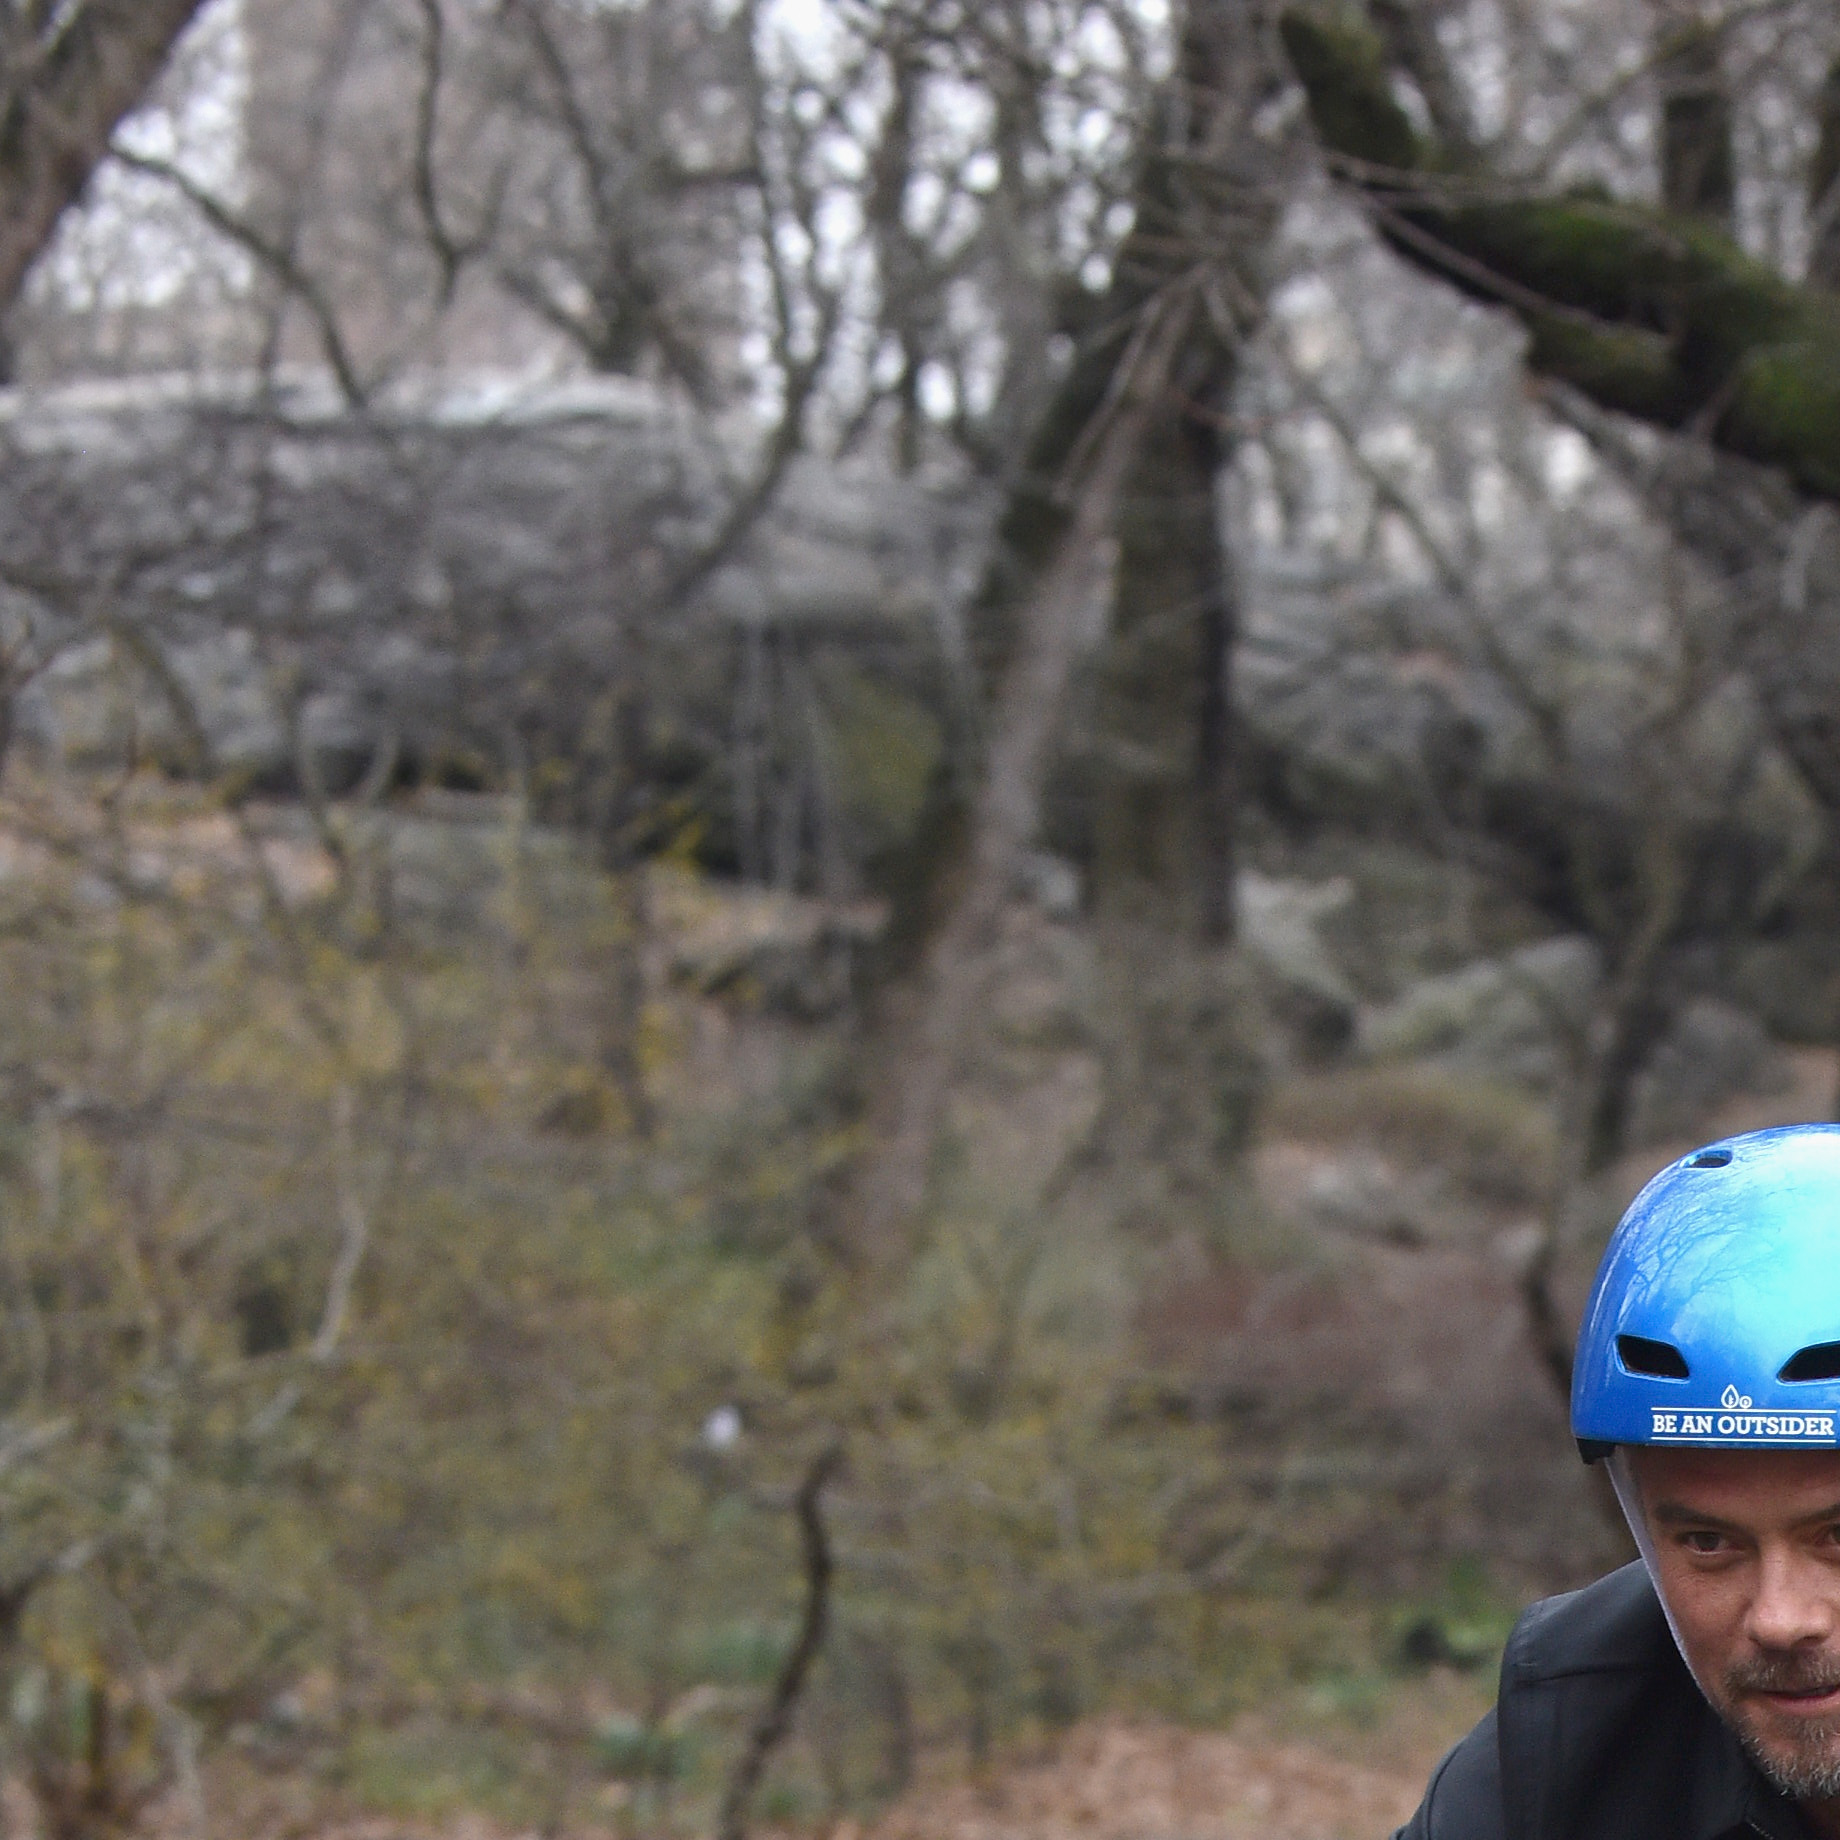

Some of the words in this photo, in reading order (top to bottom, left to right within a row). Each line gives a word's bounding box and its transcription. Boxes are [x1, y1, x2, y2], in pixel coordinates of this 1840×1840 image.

[1652, 1414, 1677, 1433] BE
[1680, 1415, 1713, 1434] AN
[1717, 1416, 1835, 1436] OUTSIDER
